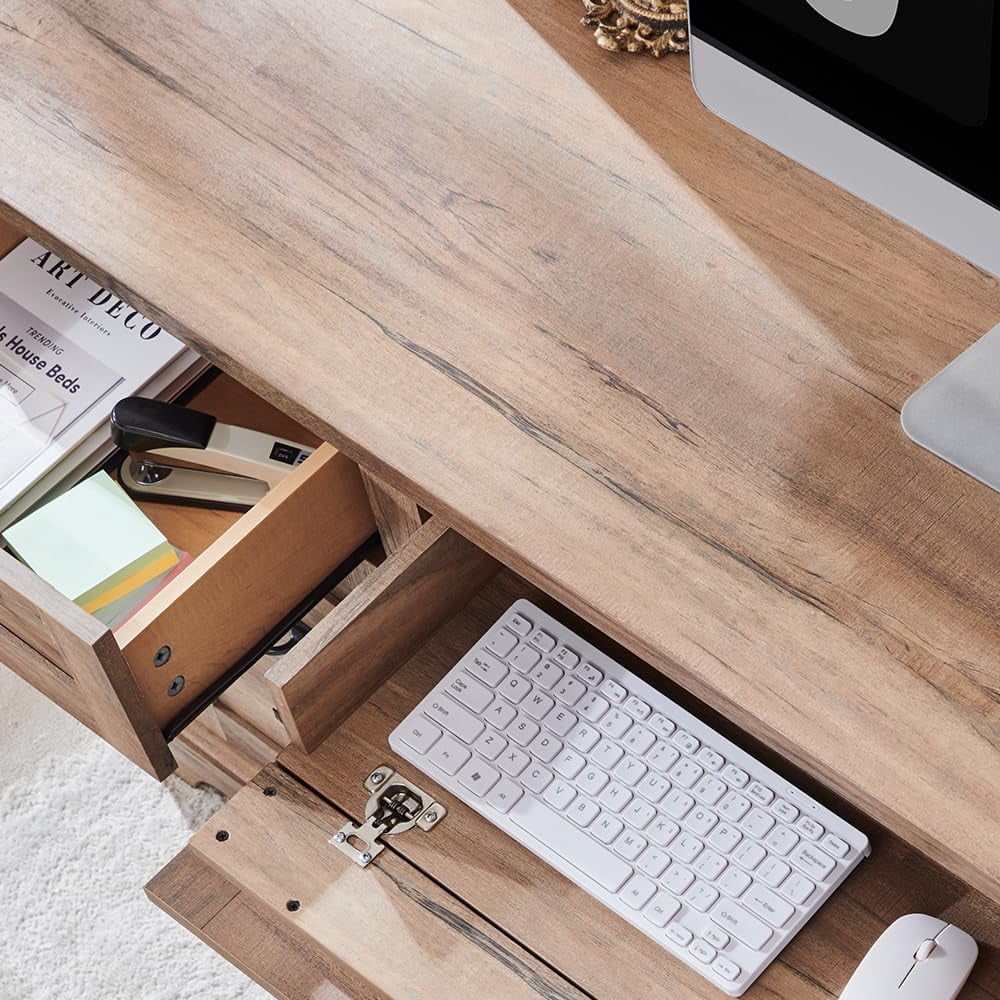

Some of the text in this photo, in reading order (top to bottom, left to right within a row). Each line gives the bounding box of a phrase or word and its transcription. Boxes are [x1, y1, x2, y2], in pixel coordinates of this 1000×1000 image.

[30, 251, 162, 341] ART DECO
[46, 288, 79, 314] Evocative
[26, 326, 64, 356] TRENDING
[5, 335, 47, 370] House
[46, 364, 81, 394] Beds
